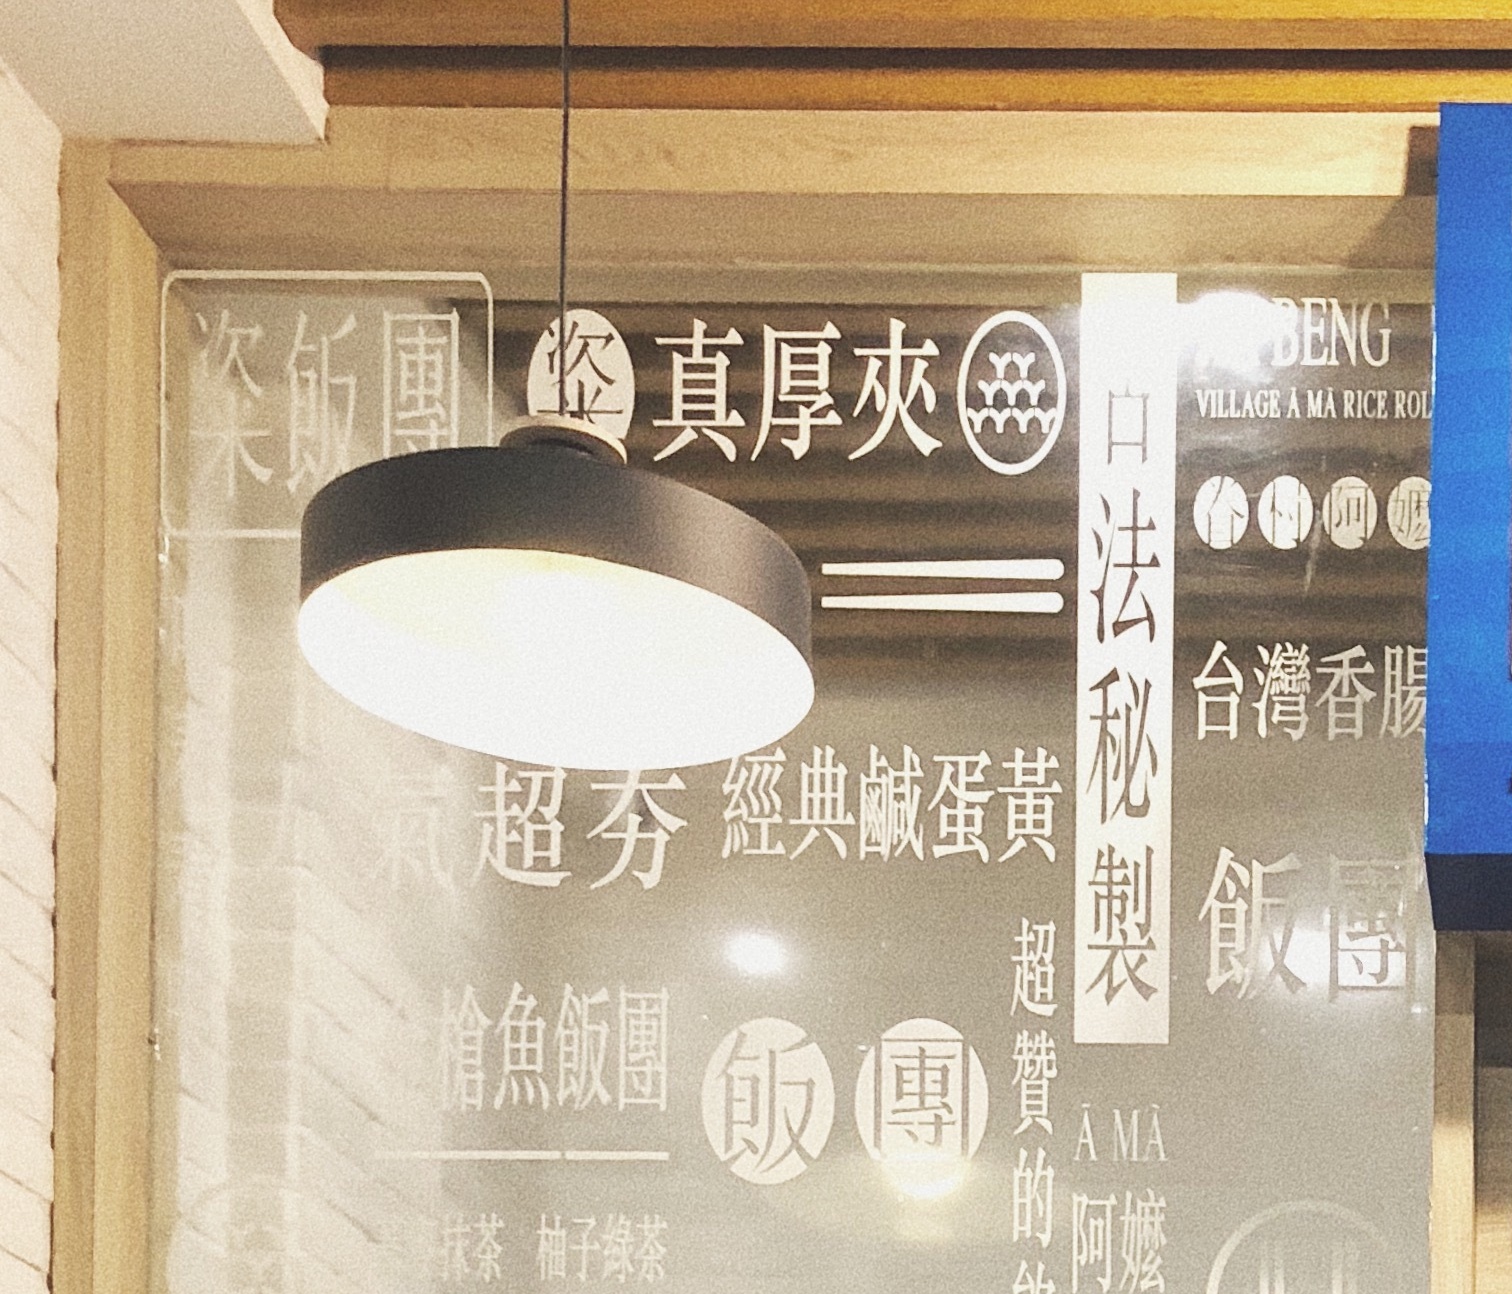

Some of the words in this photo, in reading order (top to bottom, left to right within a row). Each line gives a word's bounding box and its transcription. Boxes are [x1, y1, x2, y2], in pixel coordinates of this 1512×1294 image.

[653, 318, 943, 463] 真厚夾
[1196, 389, 1281, 419] VILLAGE
[1343, 389, 1388, 420] RICE
[1394, 389, 1433, 420] ROL
